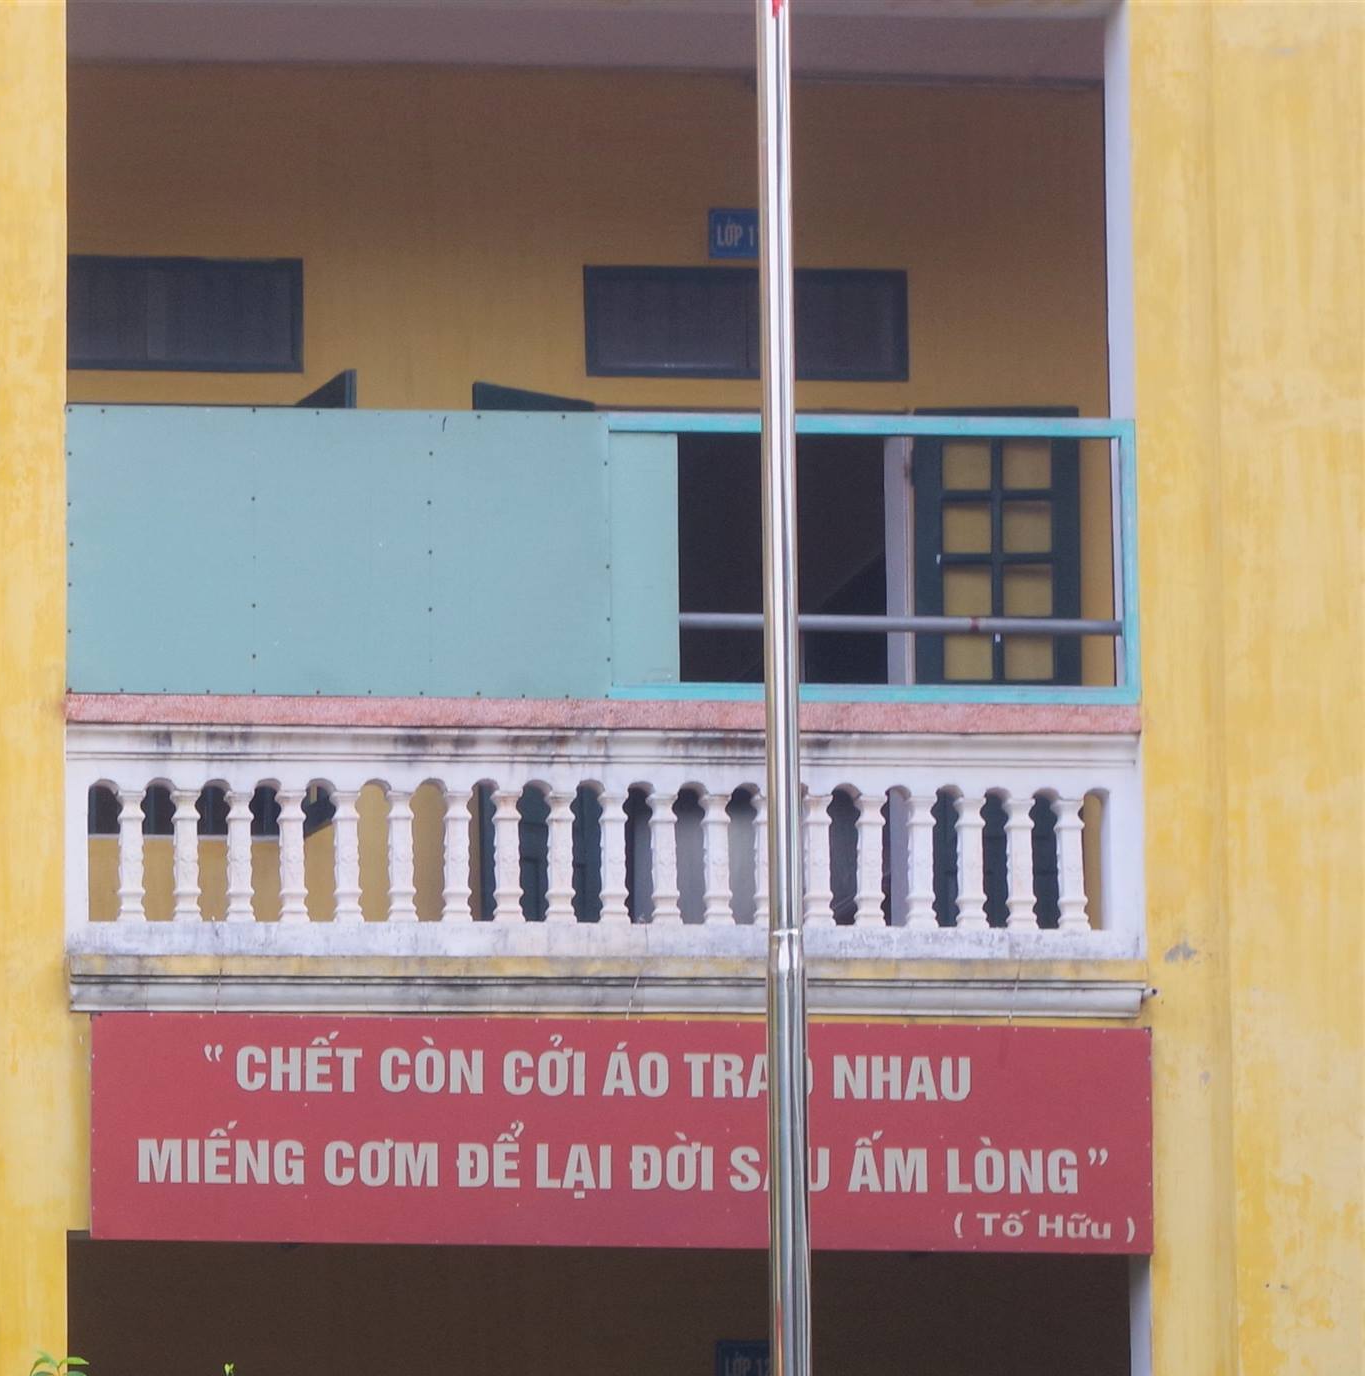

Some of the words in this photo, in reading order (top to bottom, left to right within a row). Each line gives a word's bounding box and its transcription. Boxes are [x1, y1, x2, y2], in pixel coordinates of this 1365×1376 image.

[379, 1036, 484, 1096] CÒN
[502, 1034, 587, 1097] CỞI
[602, 1041, 670, 1098] ÁO
[683, 1053, 814, 1099] TRA
[832, 1055, 972, 1102] NHAU
[137, 1120, 306, 1186] MIẾNG
[323, 1137, 439, 1188] CƠM
[456, 1120, 525, 1189] ĐỂ
[536, 1143, 613, 1200] LẠI
[629, 1131, 714, 1192] ĐỜI
[729, 1146, 830, 1193] SU
[848, 1130, 929, 1194] ẤM
